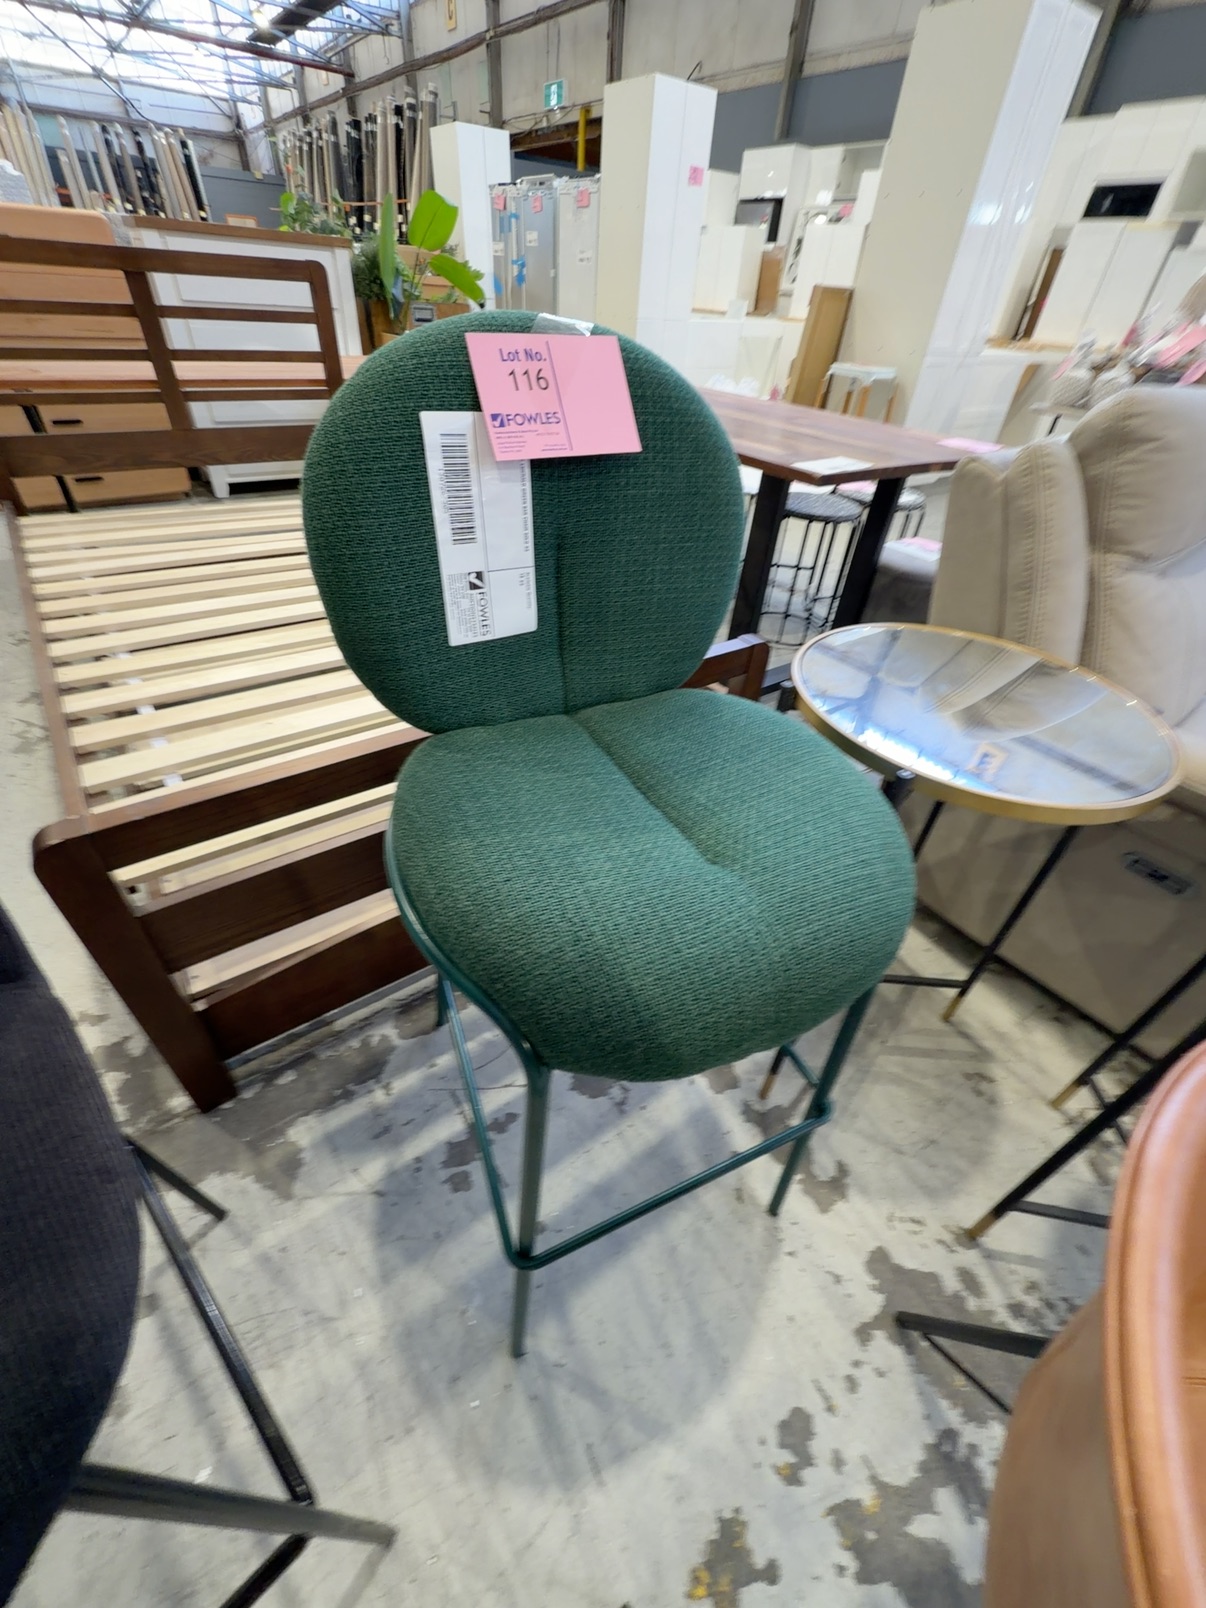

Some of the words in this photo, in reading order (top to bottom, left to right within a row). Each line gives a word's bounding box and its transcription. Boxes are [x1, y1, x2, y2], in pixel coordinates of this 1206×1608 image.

[499, 348, 522, 362] Lot
[523, 347, 547, 362] No.
[508, 368, 549, 391] 116
[505, 411, 561, 426] FOWLES
[478, 591, 492, 637] FOWLES
